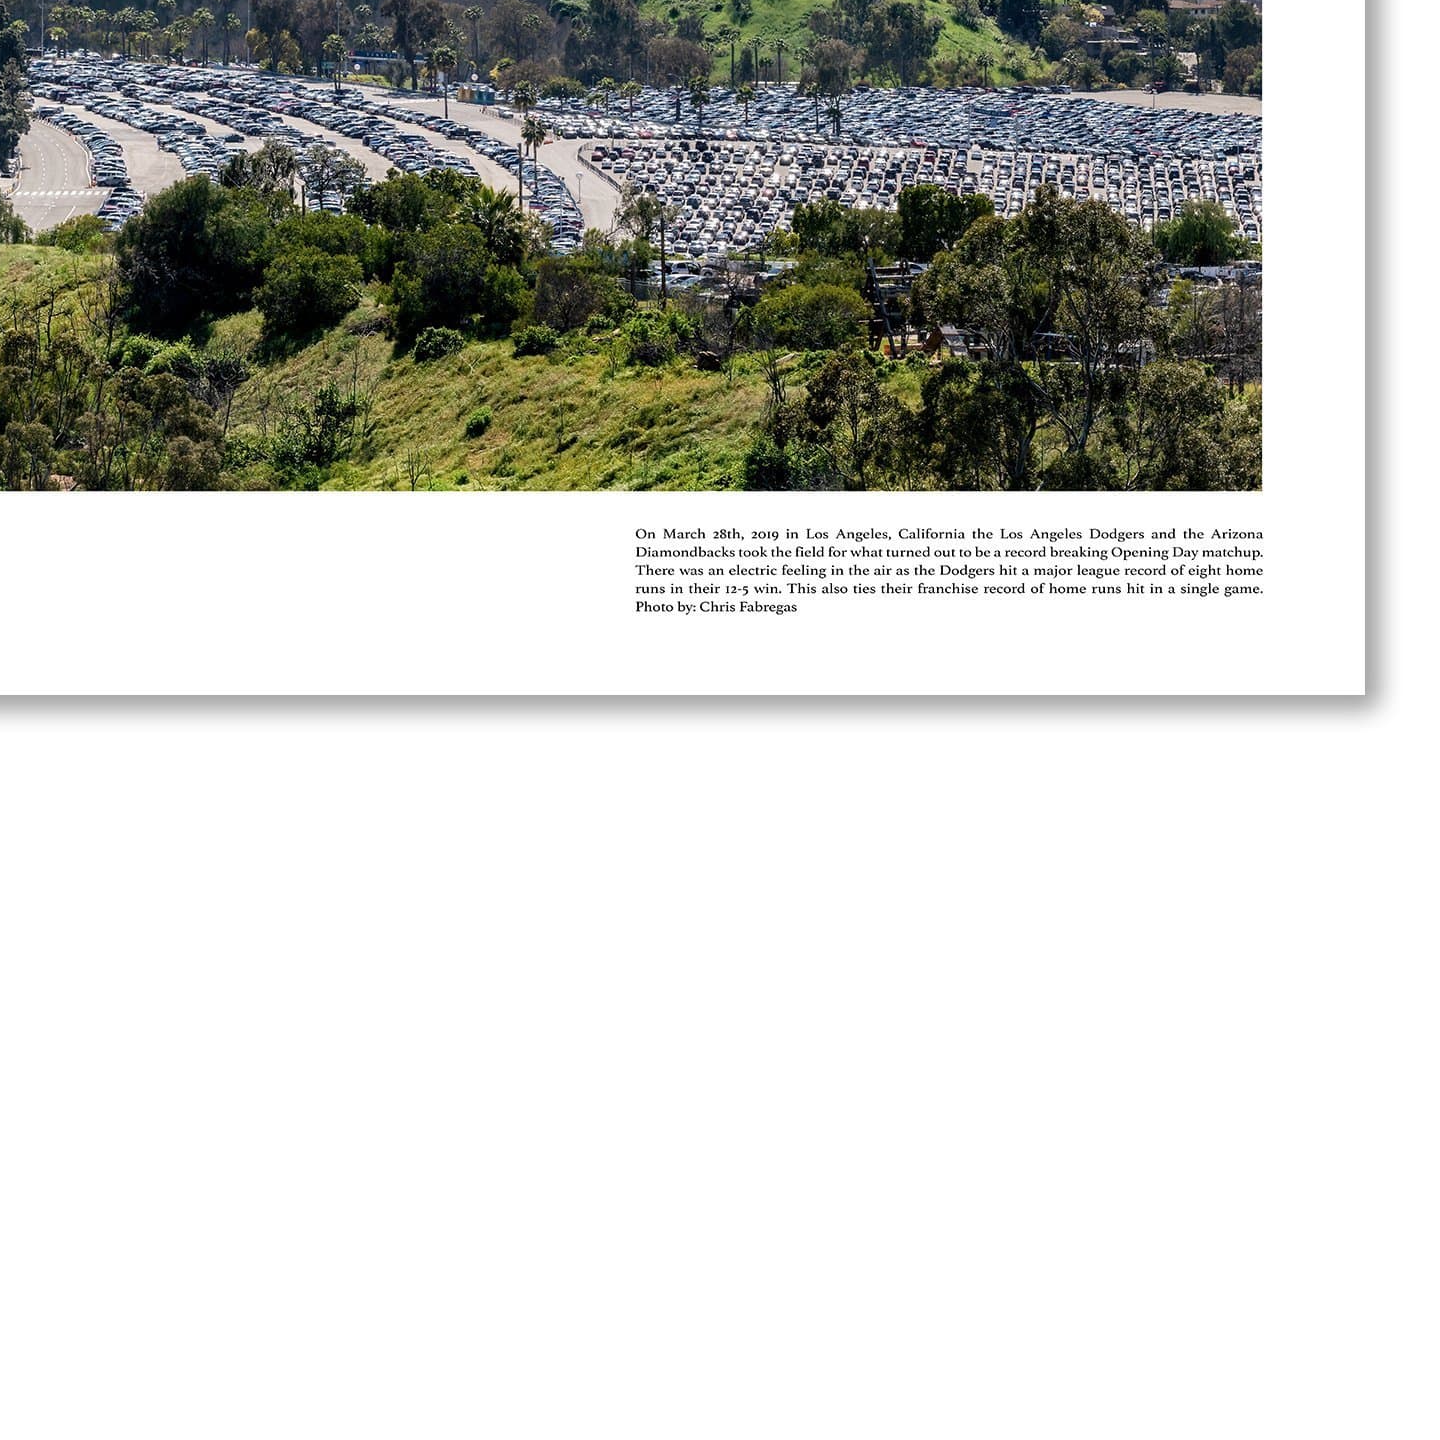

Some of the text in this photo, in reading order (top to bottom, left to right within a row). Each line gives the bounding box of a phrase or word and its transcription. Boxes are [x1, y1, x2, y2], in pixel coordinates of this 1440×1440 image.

[635, 527, 1264, 543] On March 28th, 2019 in Los Angeles, California the Los Angeles Dodgers and the Arizona
[636, 545, 1264, 561] Diamondbacks took the field for what turned out to be a record breaking Opening Day matchup.
[634, 563, 1264, 580] There was an electric feeling in the air as the Dodgers hit a major league record of eight home
[635, 582, 1264, 598] runs in their 12-5 win. This also ties their franchise record of home runs hit in a single game.
[635, 600, 798, 616] Photo by: Chris Fabregas
